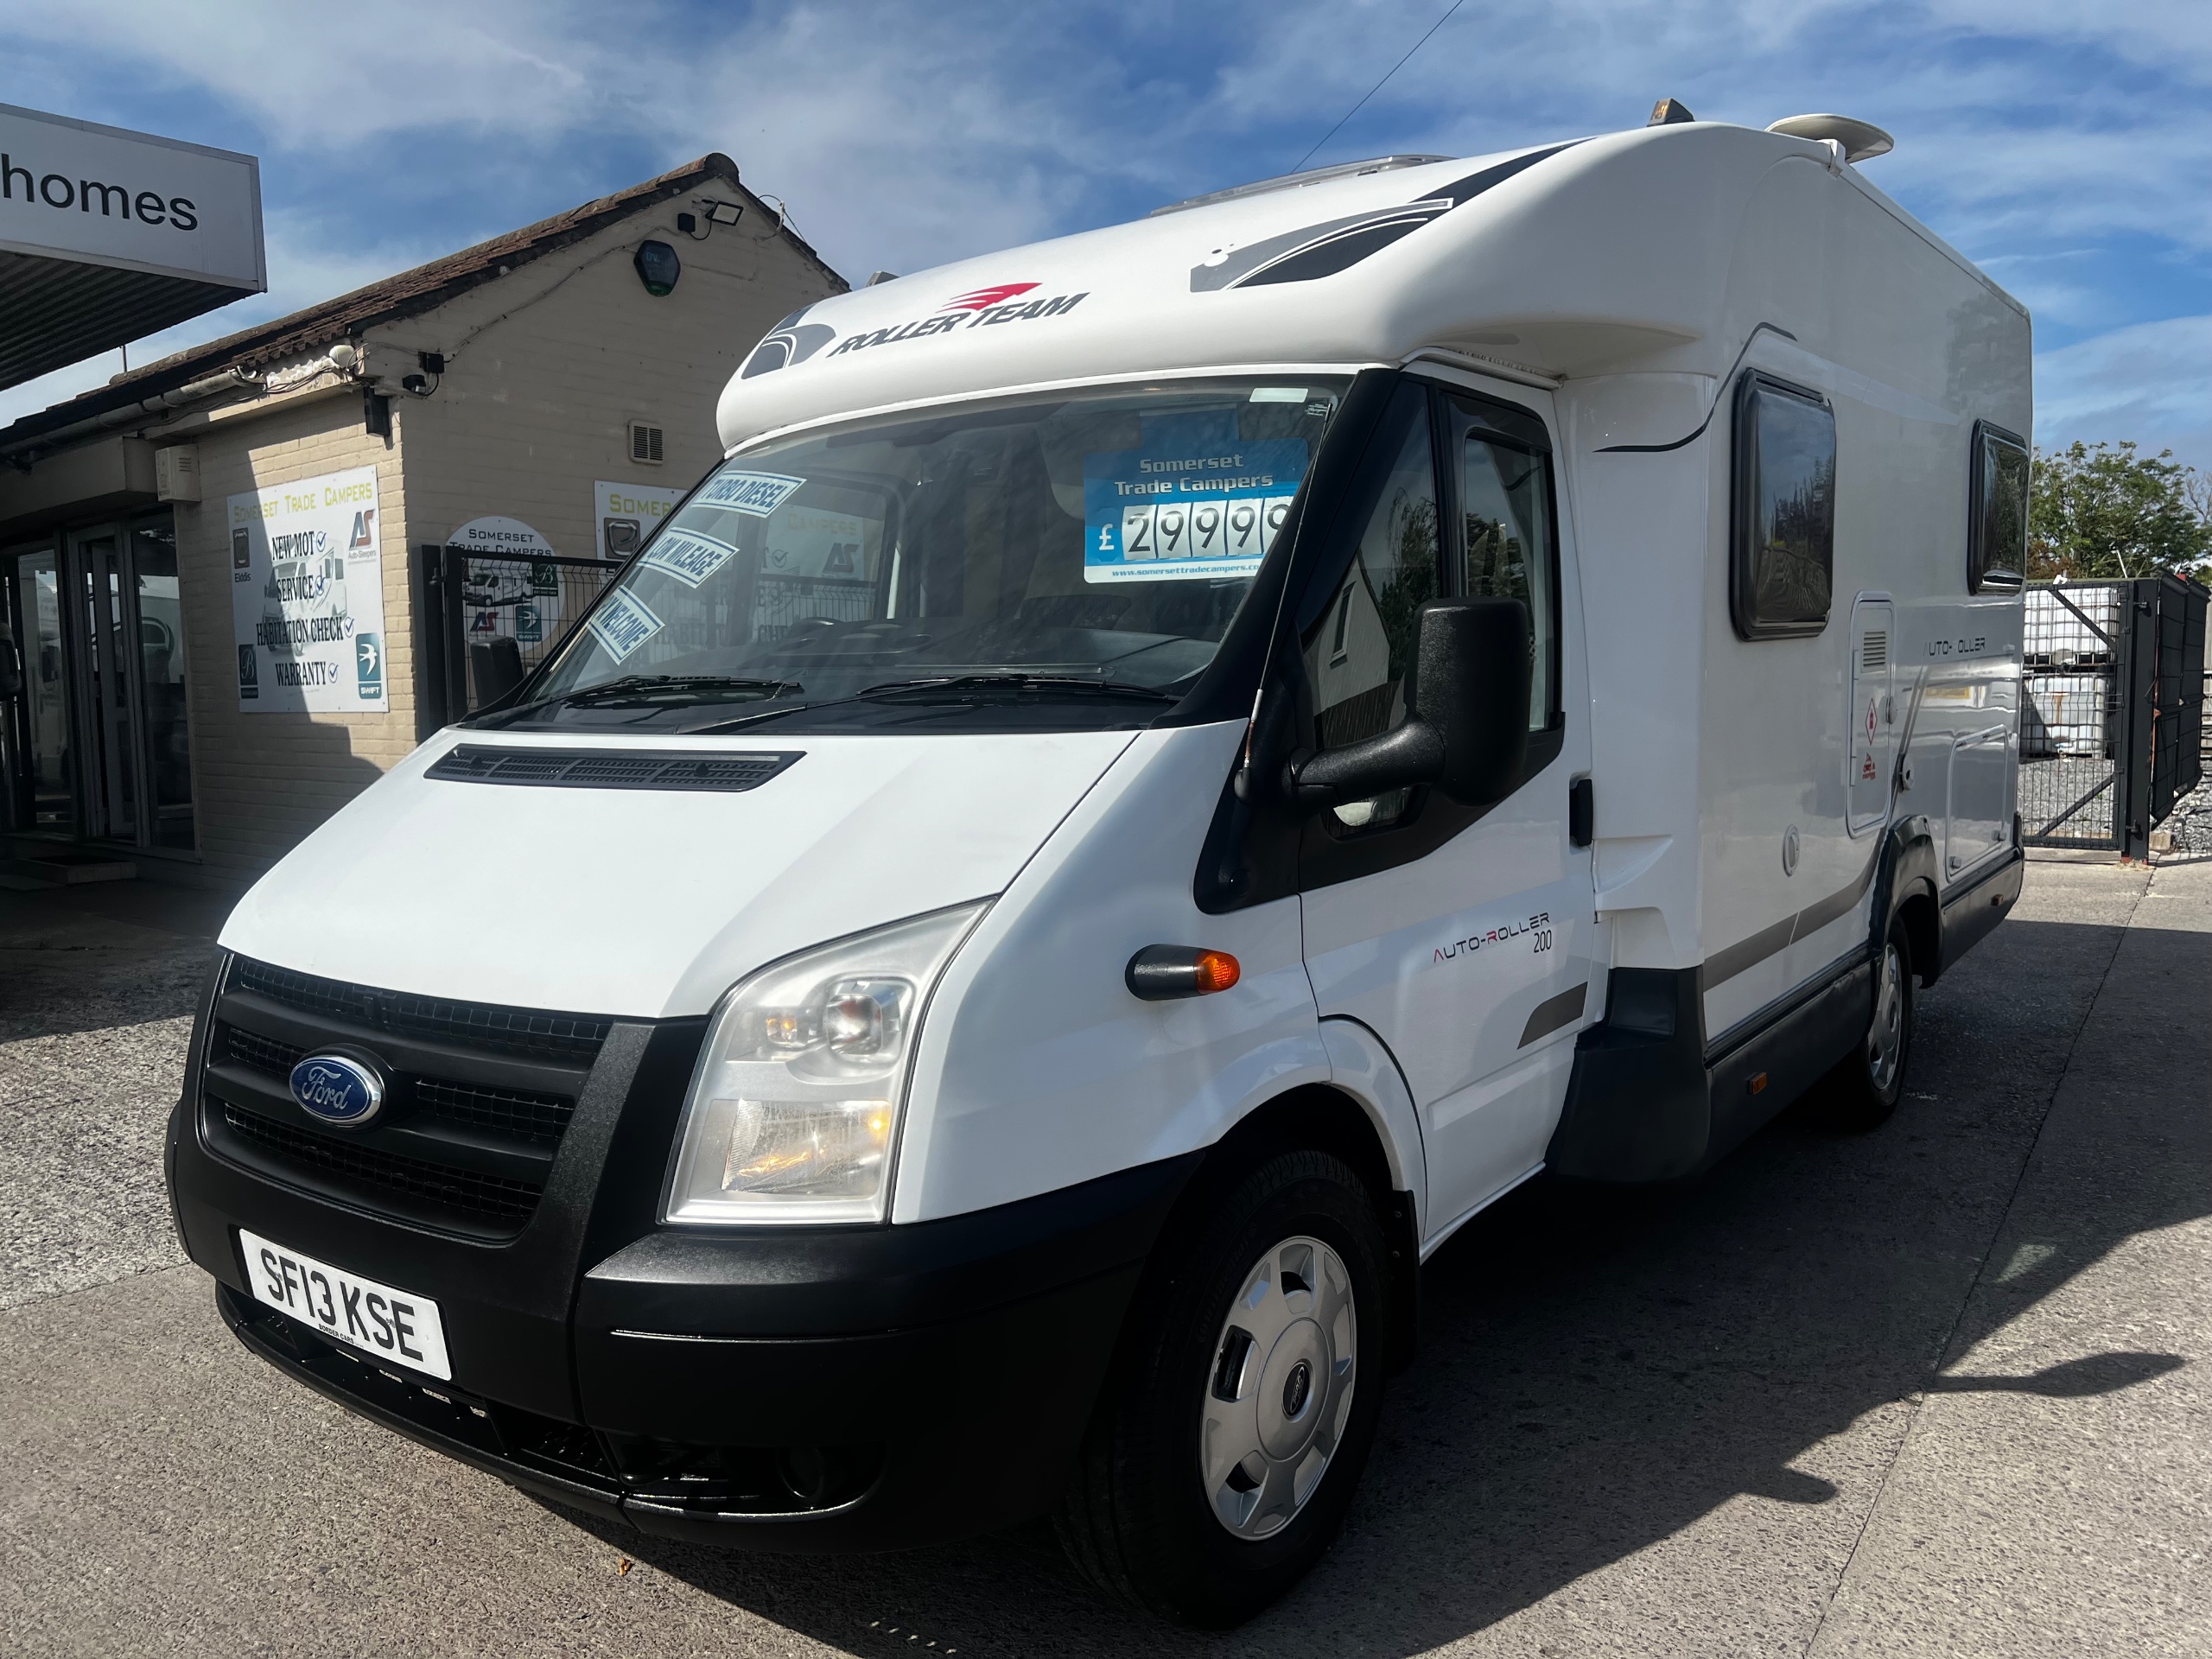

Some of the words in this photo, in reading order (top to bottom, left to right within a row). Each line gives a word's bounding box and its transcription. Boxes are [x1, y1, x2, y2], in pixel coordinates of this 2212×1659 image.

[2, 153, 198, 231] homes
[825, 312, 972, 359] ROLLER
[965, 292, 1090, 328] TEAM
[1140, 454, 1243, 474] Somerset
[285, 493, 316, 513] TRADE
[324, 482, 372, 506] CAMPERS
[701, 479, 747, 500] TURBO
[733, 481, 788, 507] DIESEL
[1114, 479, 1173, 496] Trade
[1179, 474, 1274, 494] Campers
[272, 533, 295, 561] NEW
[294, 531, 315, 557] MOT
[469, 529, 534, 543] SOMERSET
[647, 537, 682, 560] LOW
[664, 540, 723, 576] MILEAGE
[276, 575, 315, 602] SERVICE
[256, 618, 308, 646] HABITATION
[311, 616, 344, 642] CHECK
[600, 601, 650, 652] WELCOME
[275, 661, 327, 687] WARRANTY
[1433, 912, 1550, 963] AUTO-ROLLER
[1534, 930, 1552, 953] 200
[302, 1066, 352, 1109] Ford
[260, 1248, 336, 1326] SF13
[340, 1281, 423, 1362] KSE
[318, 1323, 340, 1338] BORDER
